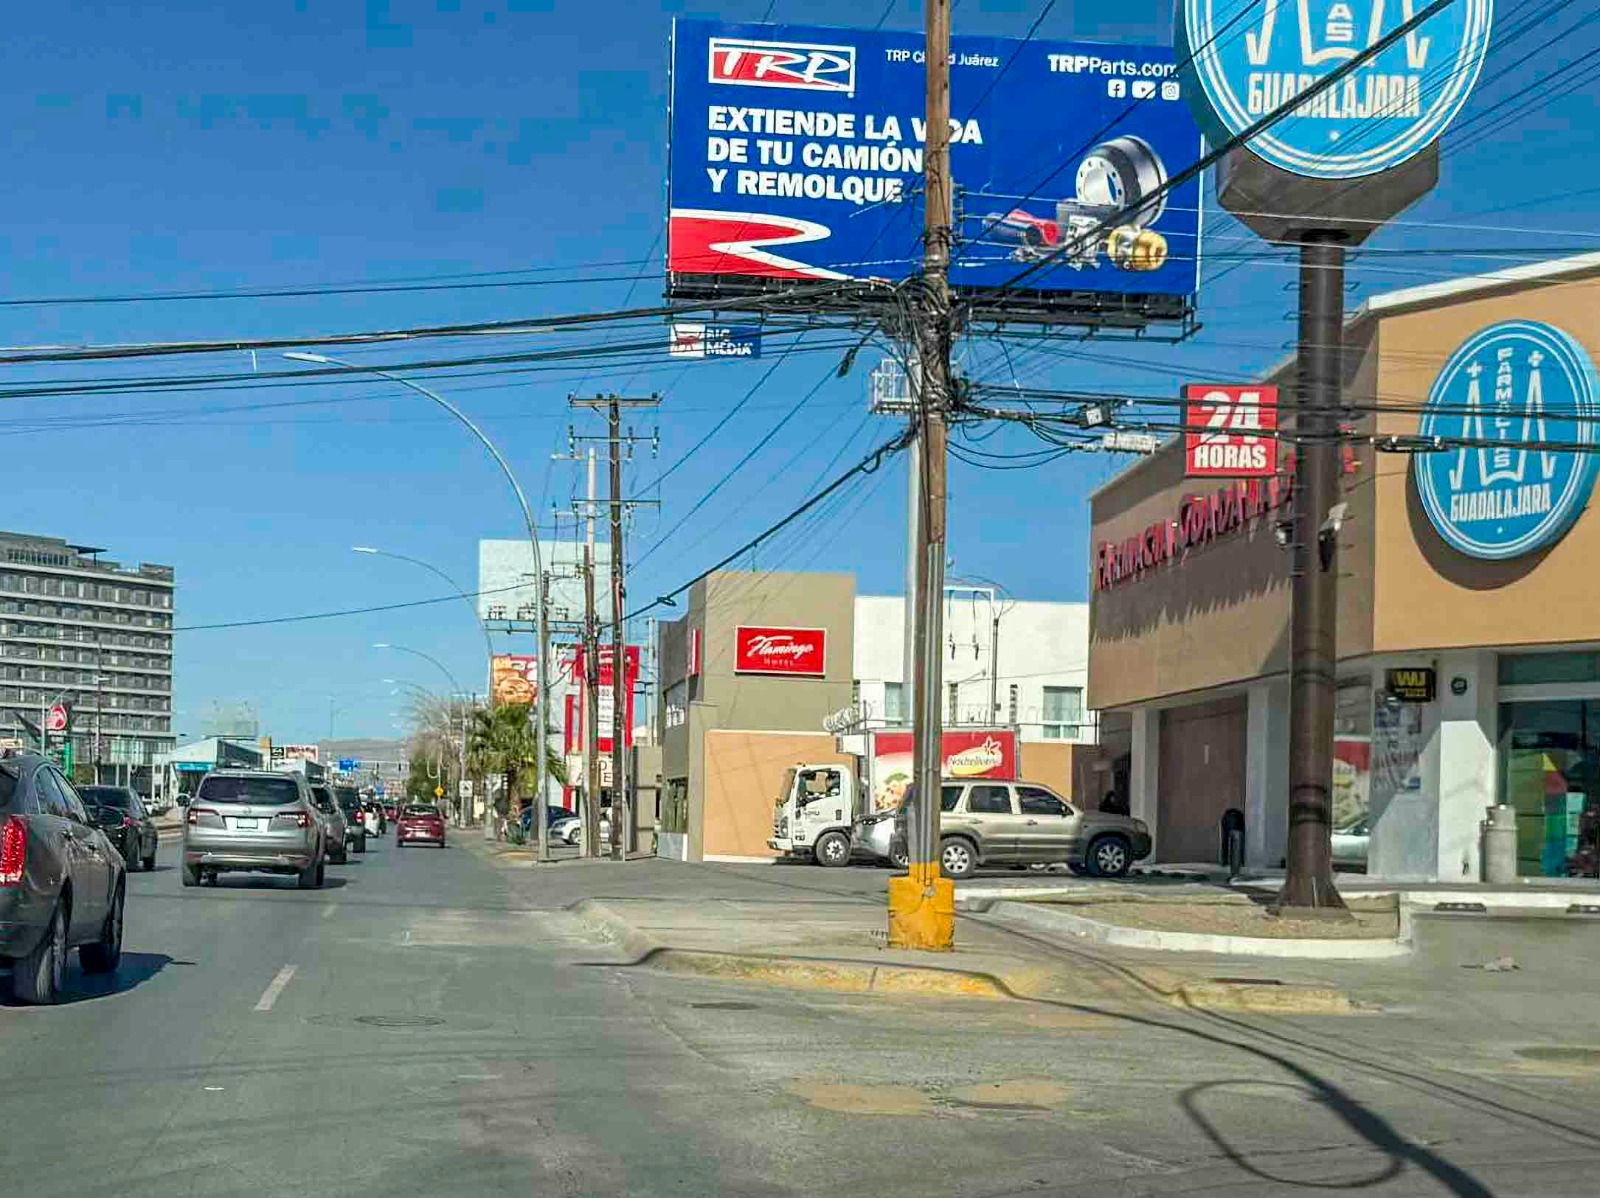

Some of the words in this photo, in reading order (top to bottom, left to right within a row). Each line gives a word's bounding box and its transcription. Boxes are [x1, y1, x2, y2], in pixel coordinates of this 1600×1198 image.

[713, 46, 852, 89] TRP
[885, 49, 910, 62] TRP
[958, 53, 999, 67] Juárez
[1048, 54, 1179, 78] TRPParts.com
[1248, 72, 1421, 119] GUADALAJARA
[708, 105, 855, 138] EXTIENDE
[864, 114, 902, 141] LA
[911, 117, 983, 144] VDA
[707, 136, 748, 164] DE
[757, 140, 793, 165] TU
[802, 142, 923, 173] CAMIÓN
[707, 167, 728, 193] Y
[737, 170, 904, 205] REMOLQUE
[1200, 391, 1262, 443] 24
[1495, 347, 1514, 469] FARMCIS
[1194, 444, 1267, 469] HORAS
[1451, 483, 1552, 522] GUADALAJARA
[746, 635, 814, 660] Flamingo
